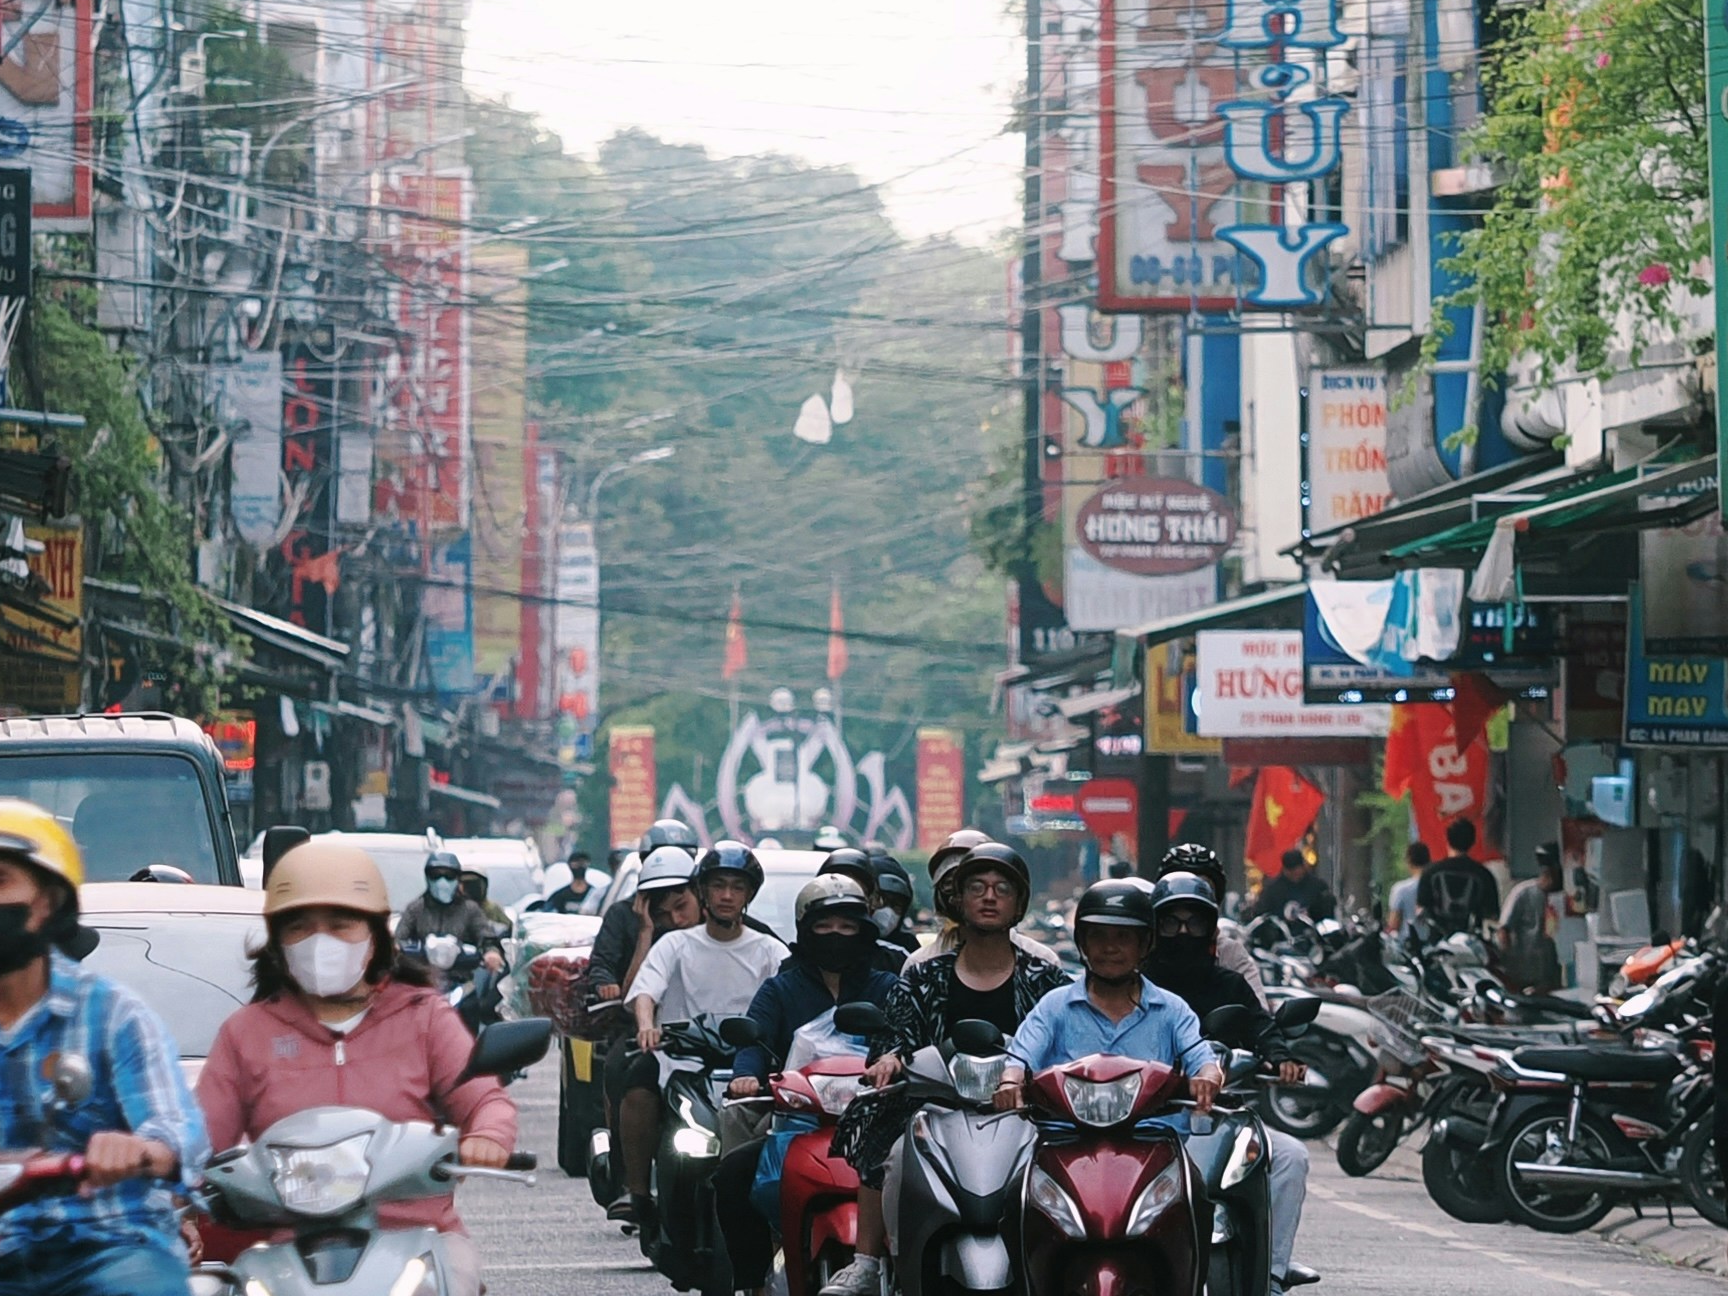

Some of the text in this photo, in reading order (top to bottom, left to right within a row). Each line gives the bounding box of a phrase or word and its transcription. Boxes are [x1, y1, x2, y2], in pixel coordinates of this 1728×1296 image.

[1322, 397, 1387, 428] PHÒN
[1332, 490, 1395, 519] RĂN
[1647, 696, 1707, 718] MAY
